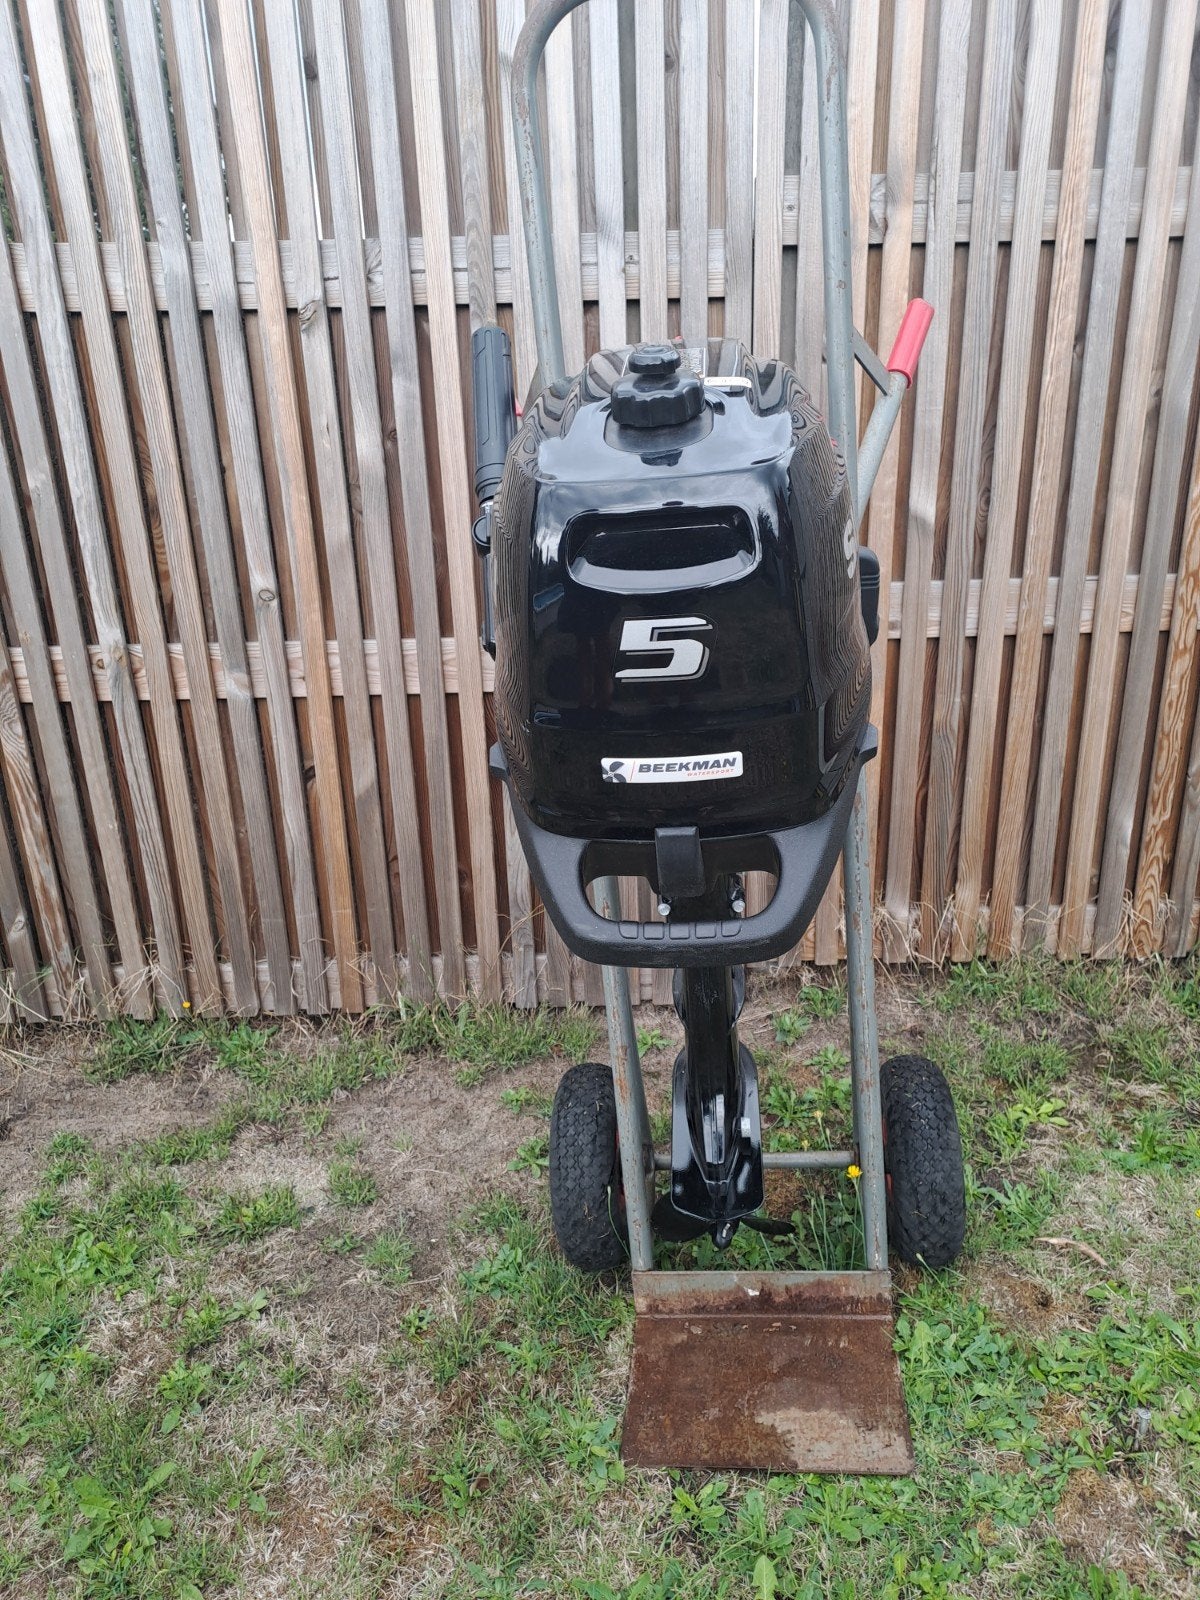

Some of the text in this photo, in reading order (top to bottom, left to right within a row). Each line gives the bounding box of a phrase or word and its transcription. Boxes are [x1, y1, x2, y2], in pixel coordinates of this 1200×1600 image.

[615, 616, 713, 682] 5
[638, 757, 737, 773] BEEKMAN
[687, 768, 735, 777] WATERSPORT
